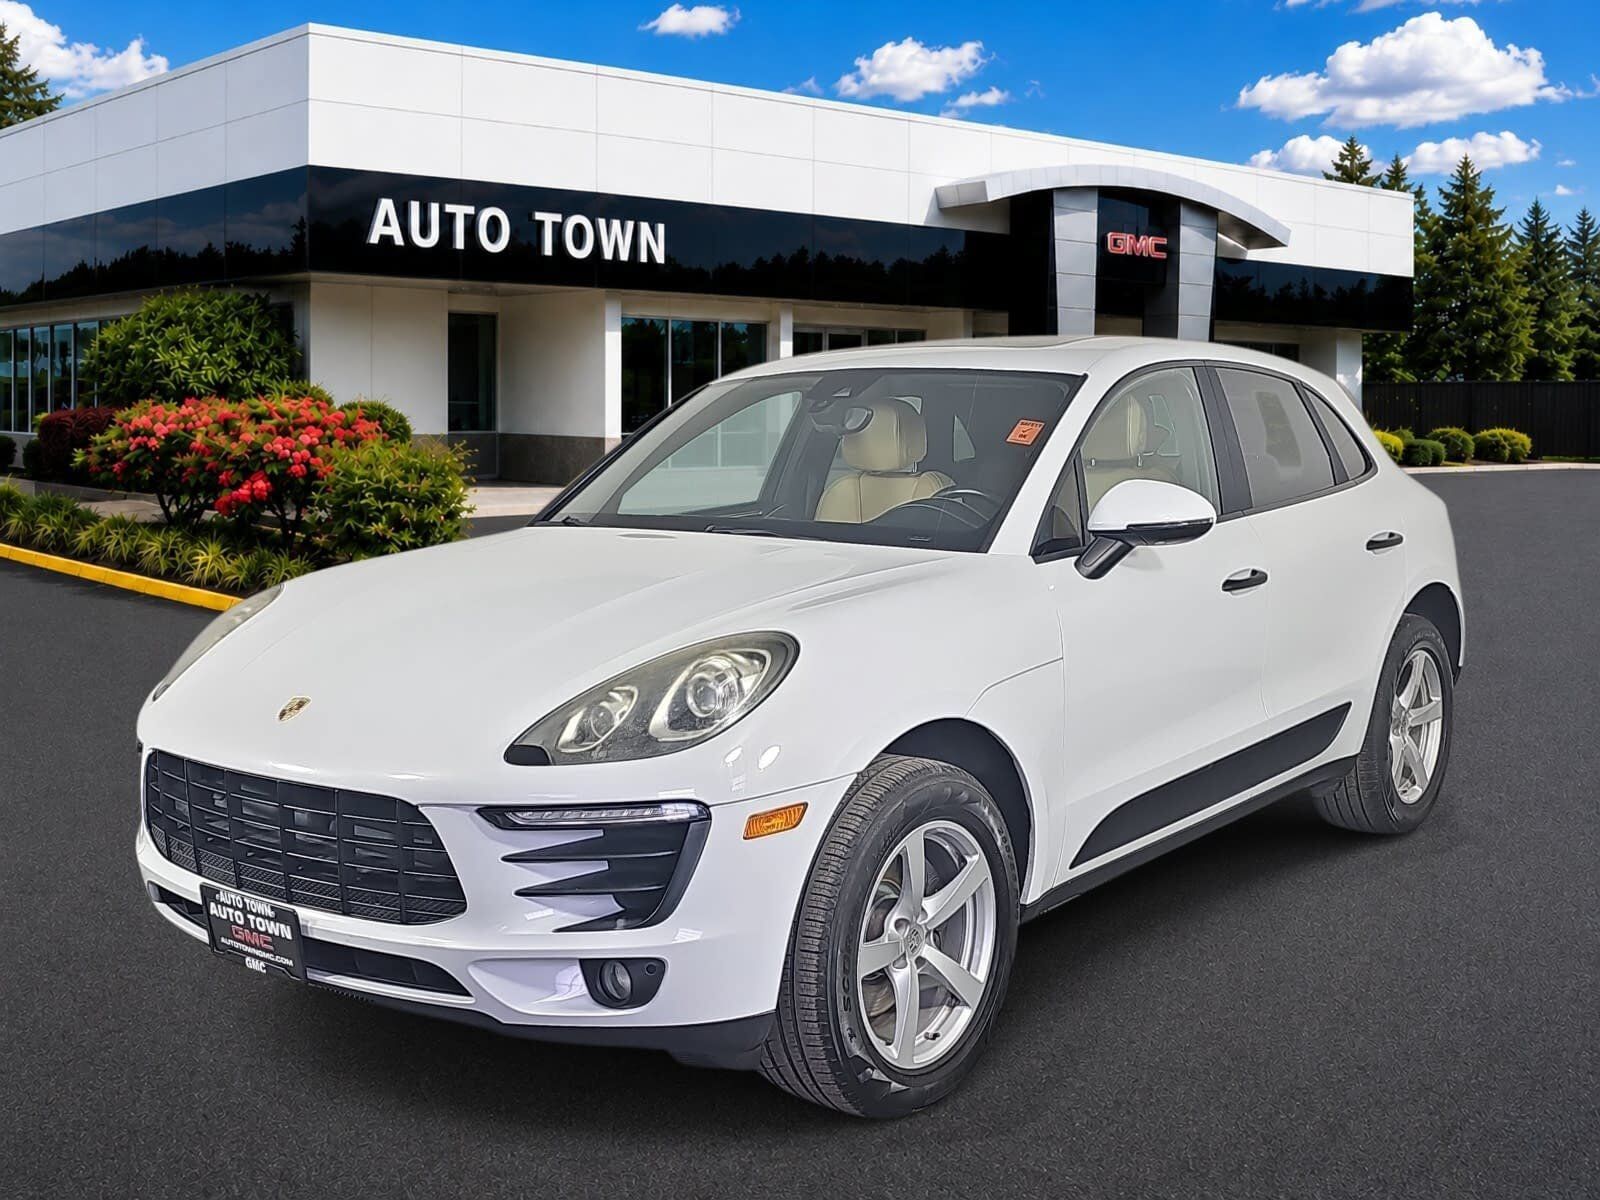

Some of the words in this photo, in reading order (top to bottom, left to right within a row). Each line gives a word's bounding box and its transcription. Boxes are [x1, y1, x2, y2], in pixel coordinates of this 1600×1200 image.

[366, 197, 511, 253] AUTO
[532, 210, 666, 264] TOWN
[1107, 231, 1168, 259] GMC
[219, 890, 243, 909] AUTO
[243, 898, 272, 917] TOWN
[209, 901, 244, 926] AUTO
[246, 914, 292, 940] TOWN
[231, 925, 274, 951] GMC
[245, 956, 267, 974] GMC
